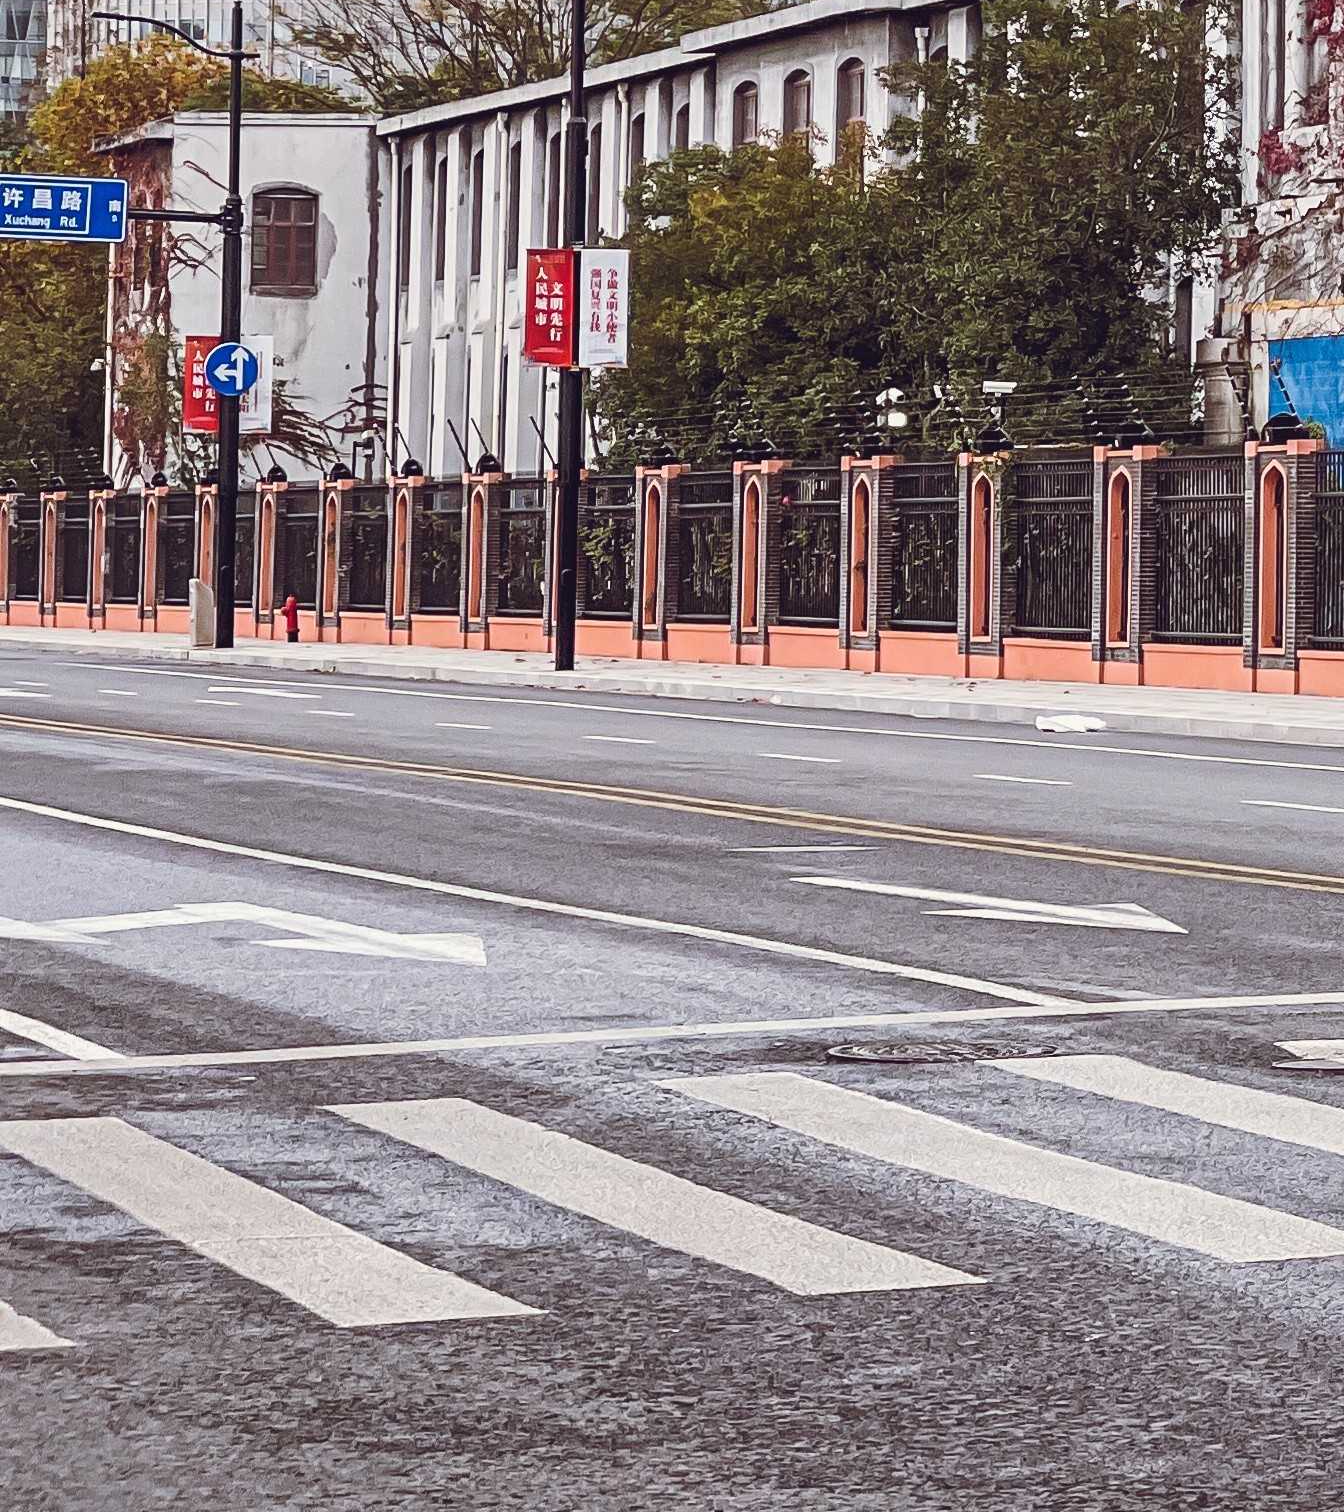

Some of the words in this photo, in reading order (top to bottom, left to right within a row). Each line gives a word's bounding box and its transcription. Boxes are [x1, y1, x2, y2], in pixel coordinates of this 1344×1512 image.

[2, 187, 82, 211] 许昌路
[4, 213, 50, 229] Xuchang
[60, 216, 78, 228] Rd.
[535, 266, 548, 326] 人民城市
[550, 282, 563, 341] 文明先行
